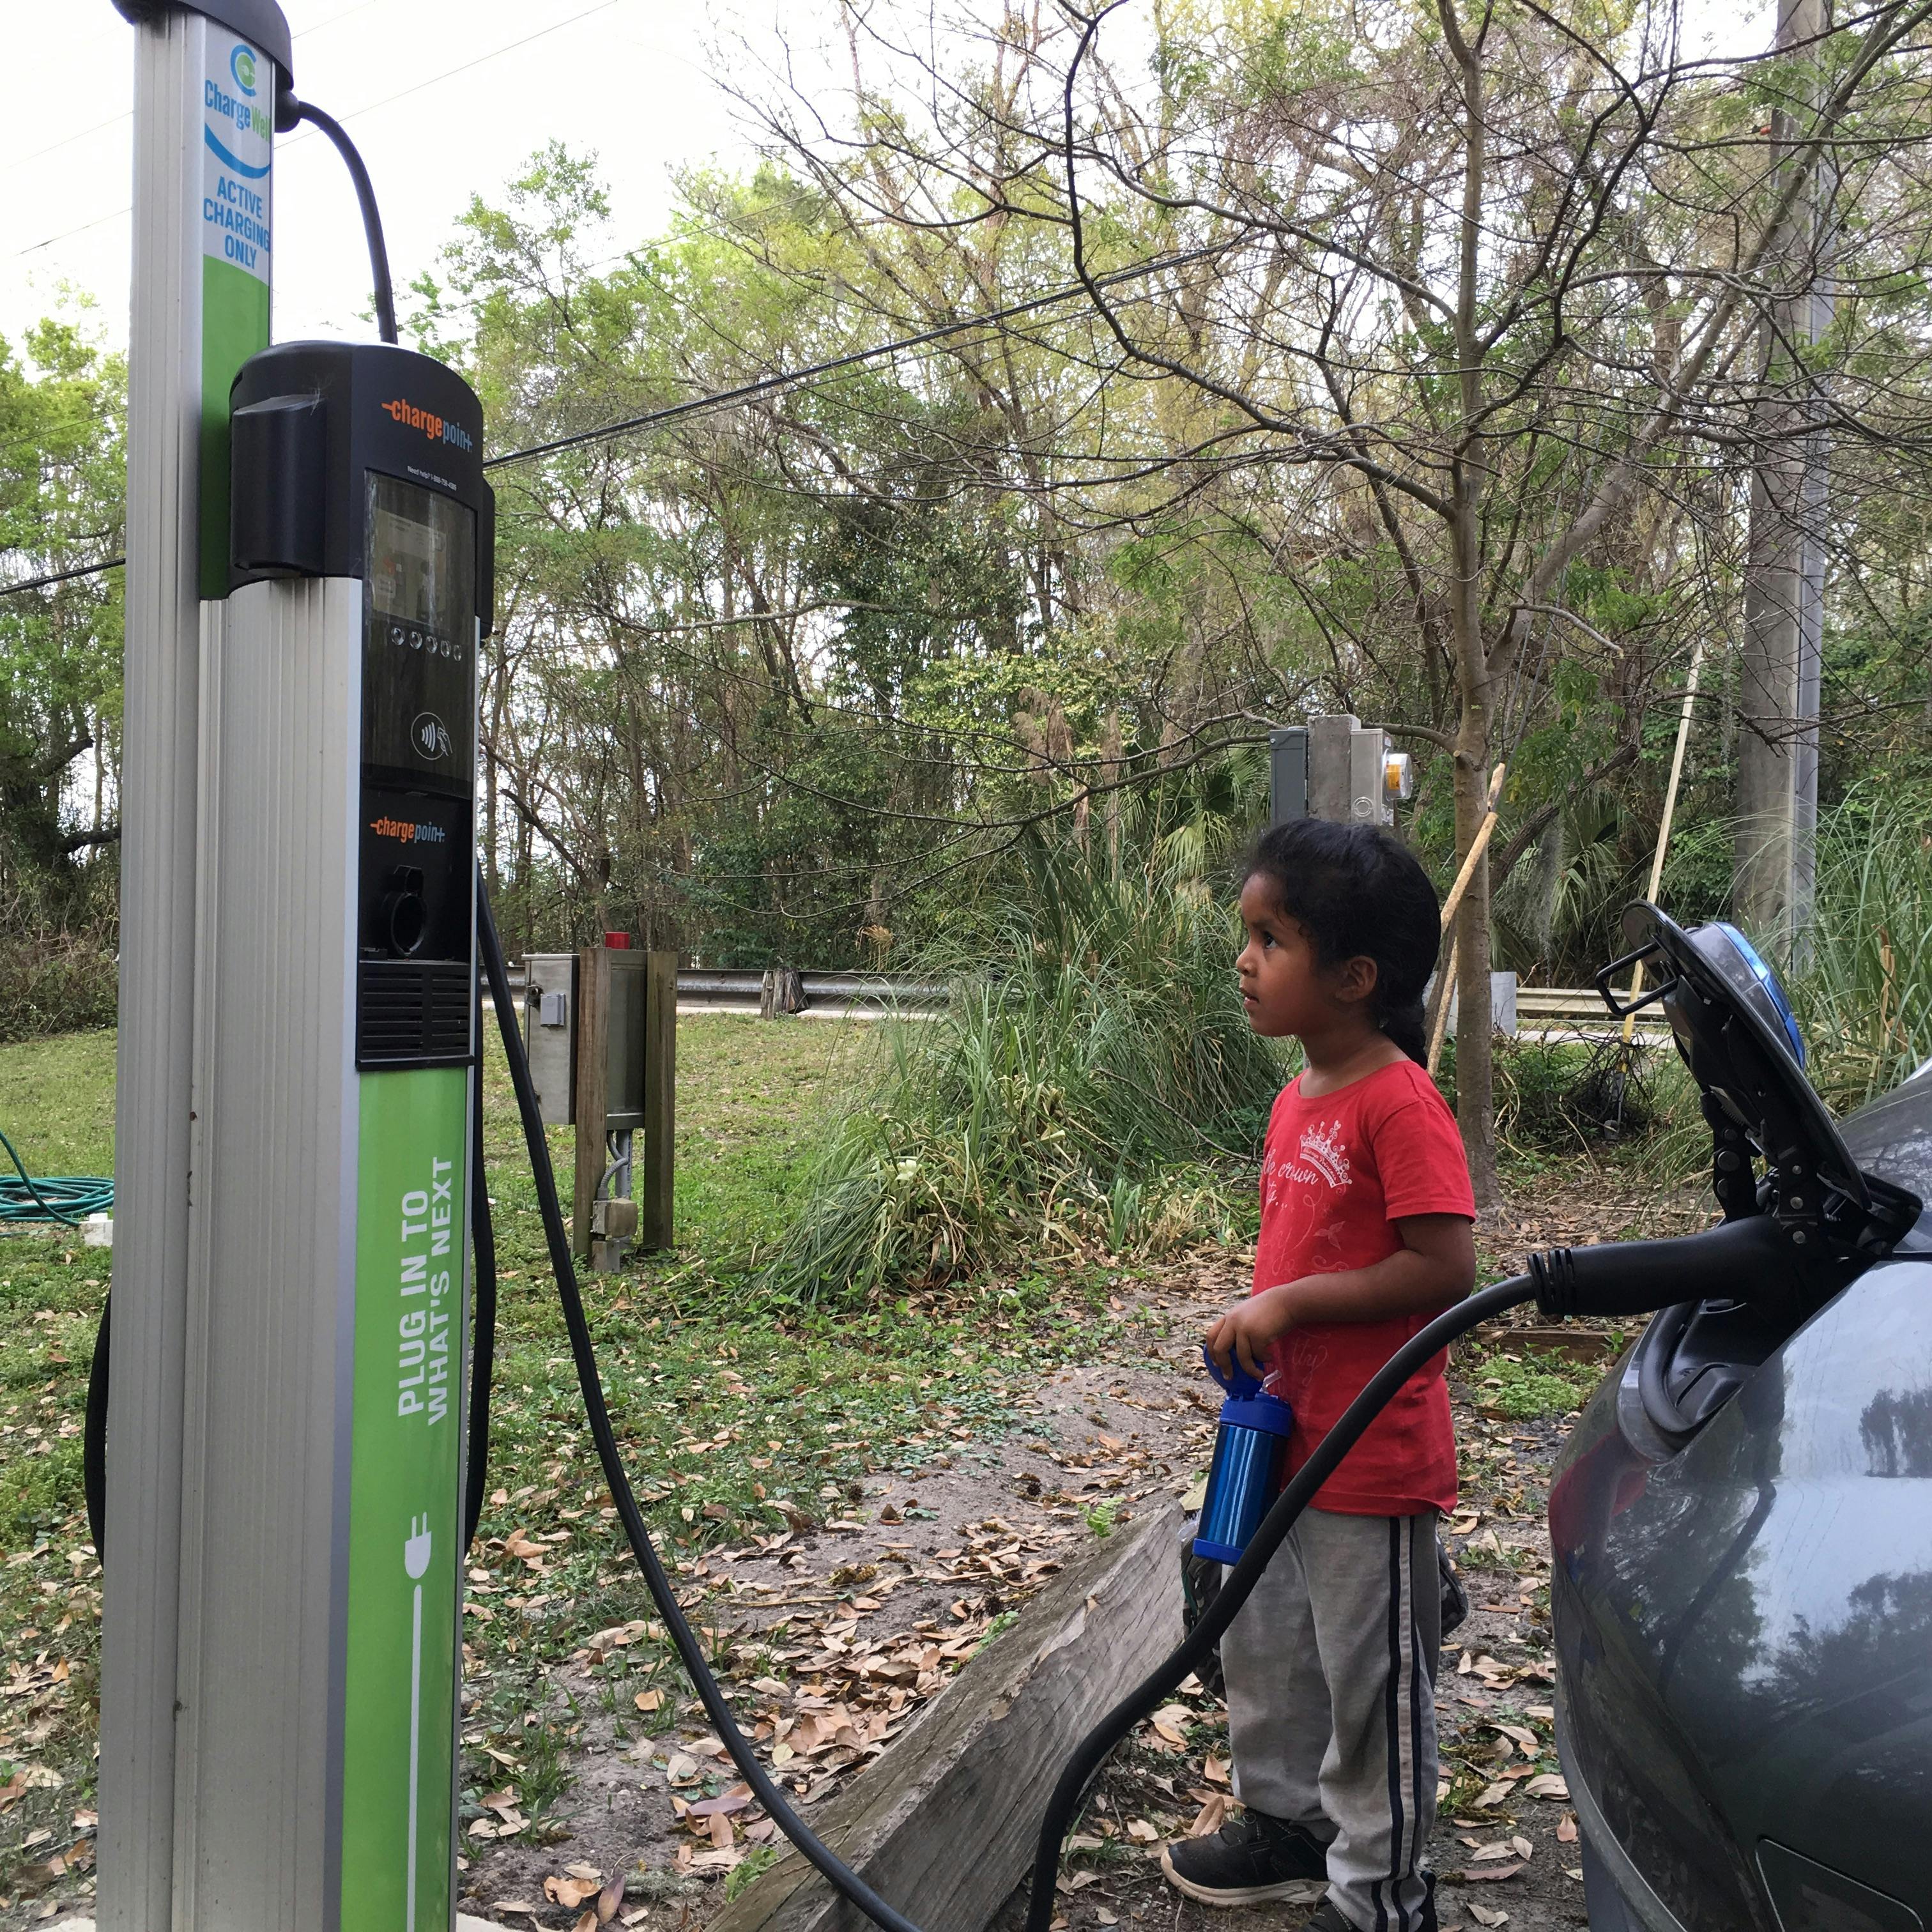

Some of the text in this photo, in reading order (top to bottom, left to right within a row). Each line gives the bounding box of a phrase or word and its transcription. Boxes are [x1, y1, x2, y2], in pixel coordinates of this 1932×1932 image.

[217, 176, 262, 219] ACTIVE
[204, 197, 270, 252] CHARGING
[225, 234, 257, 269] ONLY
[381, 398, 473, 452] chargepoint
[370, 816, 445, 843] chargepoint
[1278, 1162, 1319, 1186] crown
[398, 1190, 428, 1417] PLUG IN TO
[428, 1157, 452, 1426] WHAT'S NEXT
